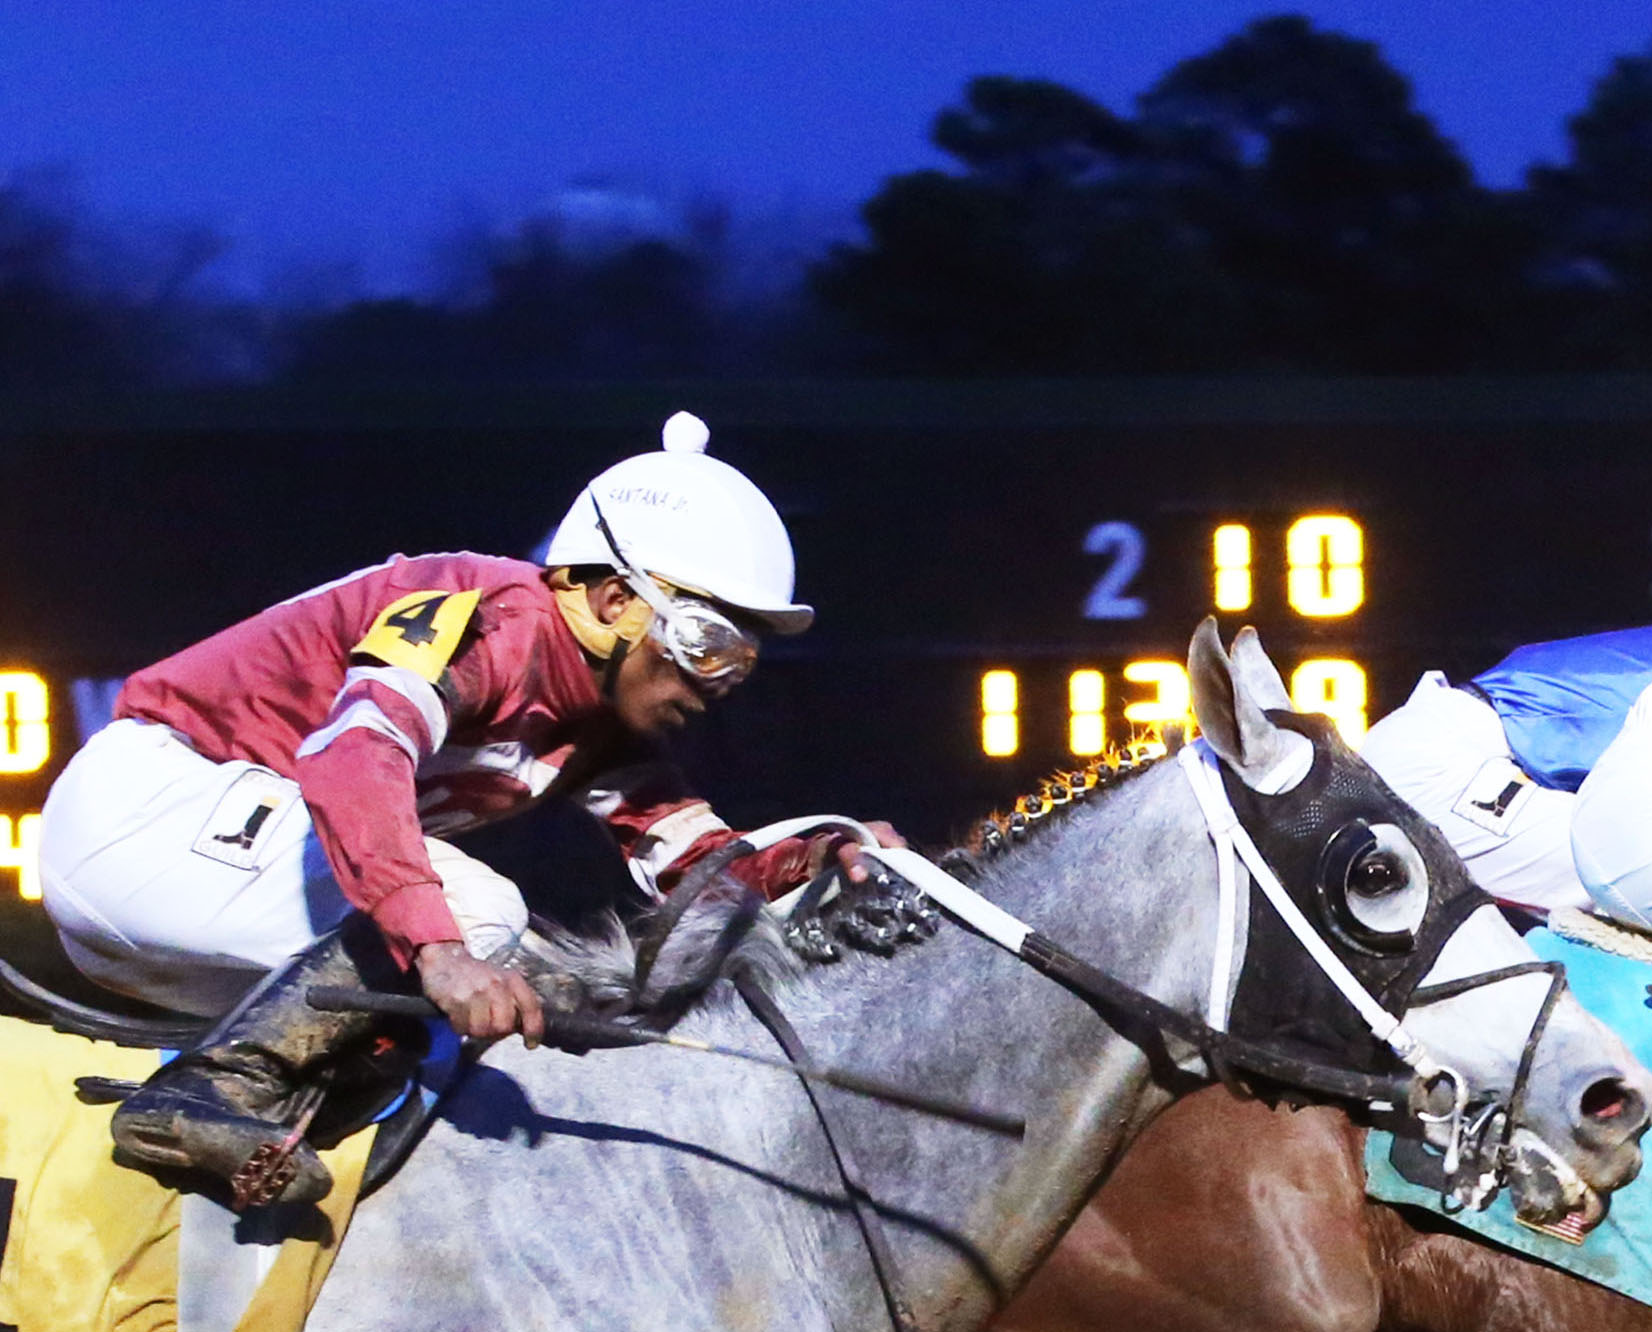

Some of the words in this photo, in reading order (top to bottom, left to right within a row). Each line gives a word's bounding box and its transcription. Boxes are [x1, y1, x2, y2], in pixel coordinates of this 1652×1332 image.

[1084, 521, 1147, 618] 2
[1213, 515, 1365, 617] 10
[385, 594, 450, 647] 4
